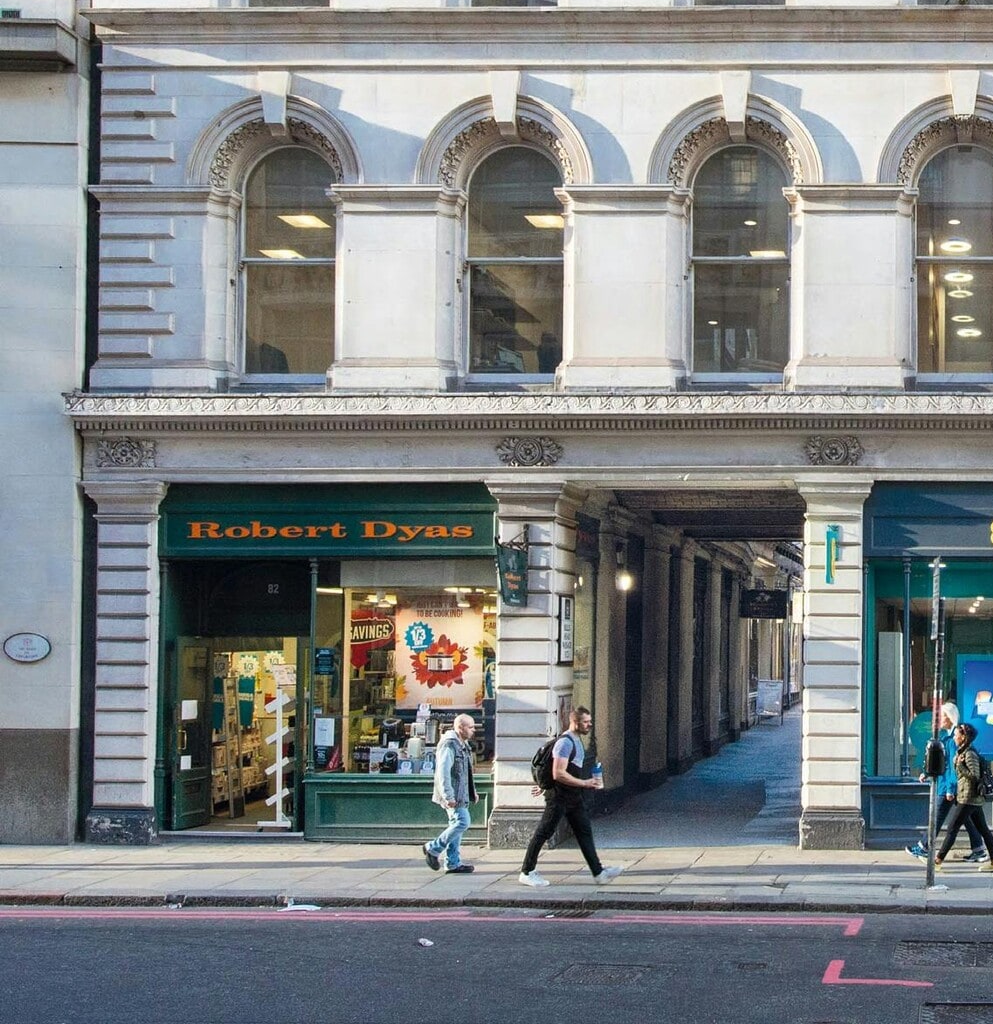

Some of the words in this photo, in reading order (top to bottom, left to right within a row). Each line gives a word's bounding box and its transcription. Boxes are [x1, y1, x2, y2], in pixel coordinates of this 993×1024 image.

[186, 521, 348, 539] Robert
[360, 521, 475, 542] Dyas
[267, 583, 280, 595] 82
